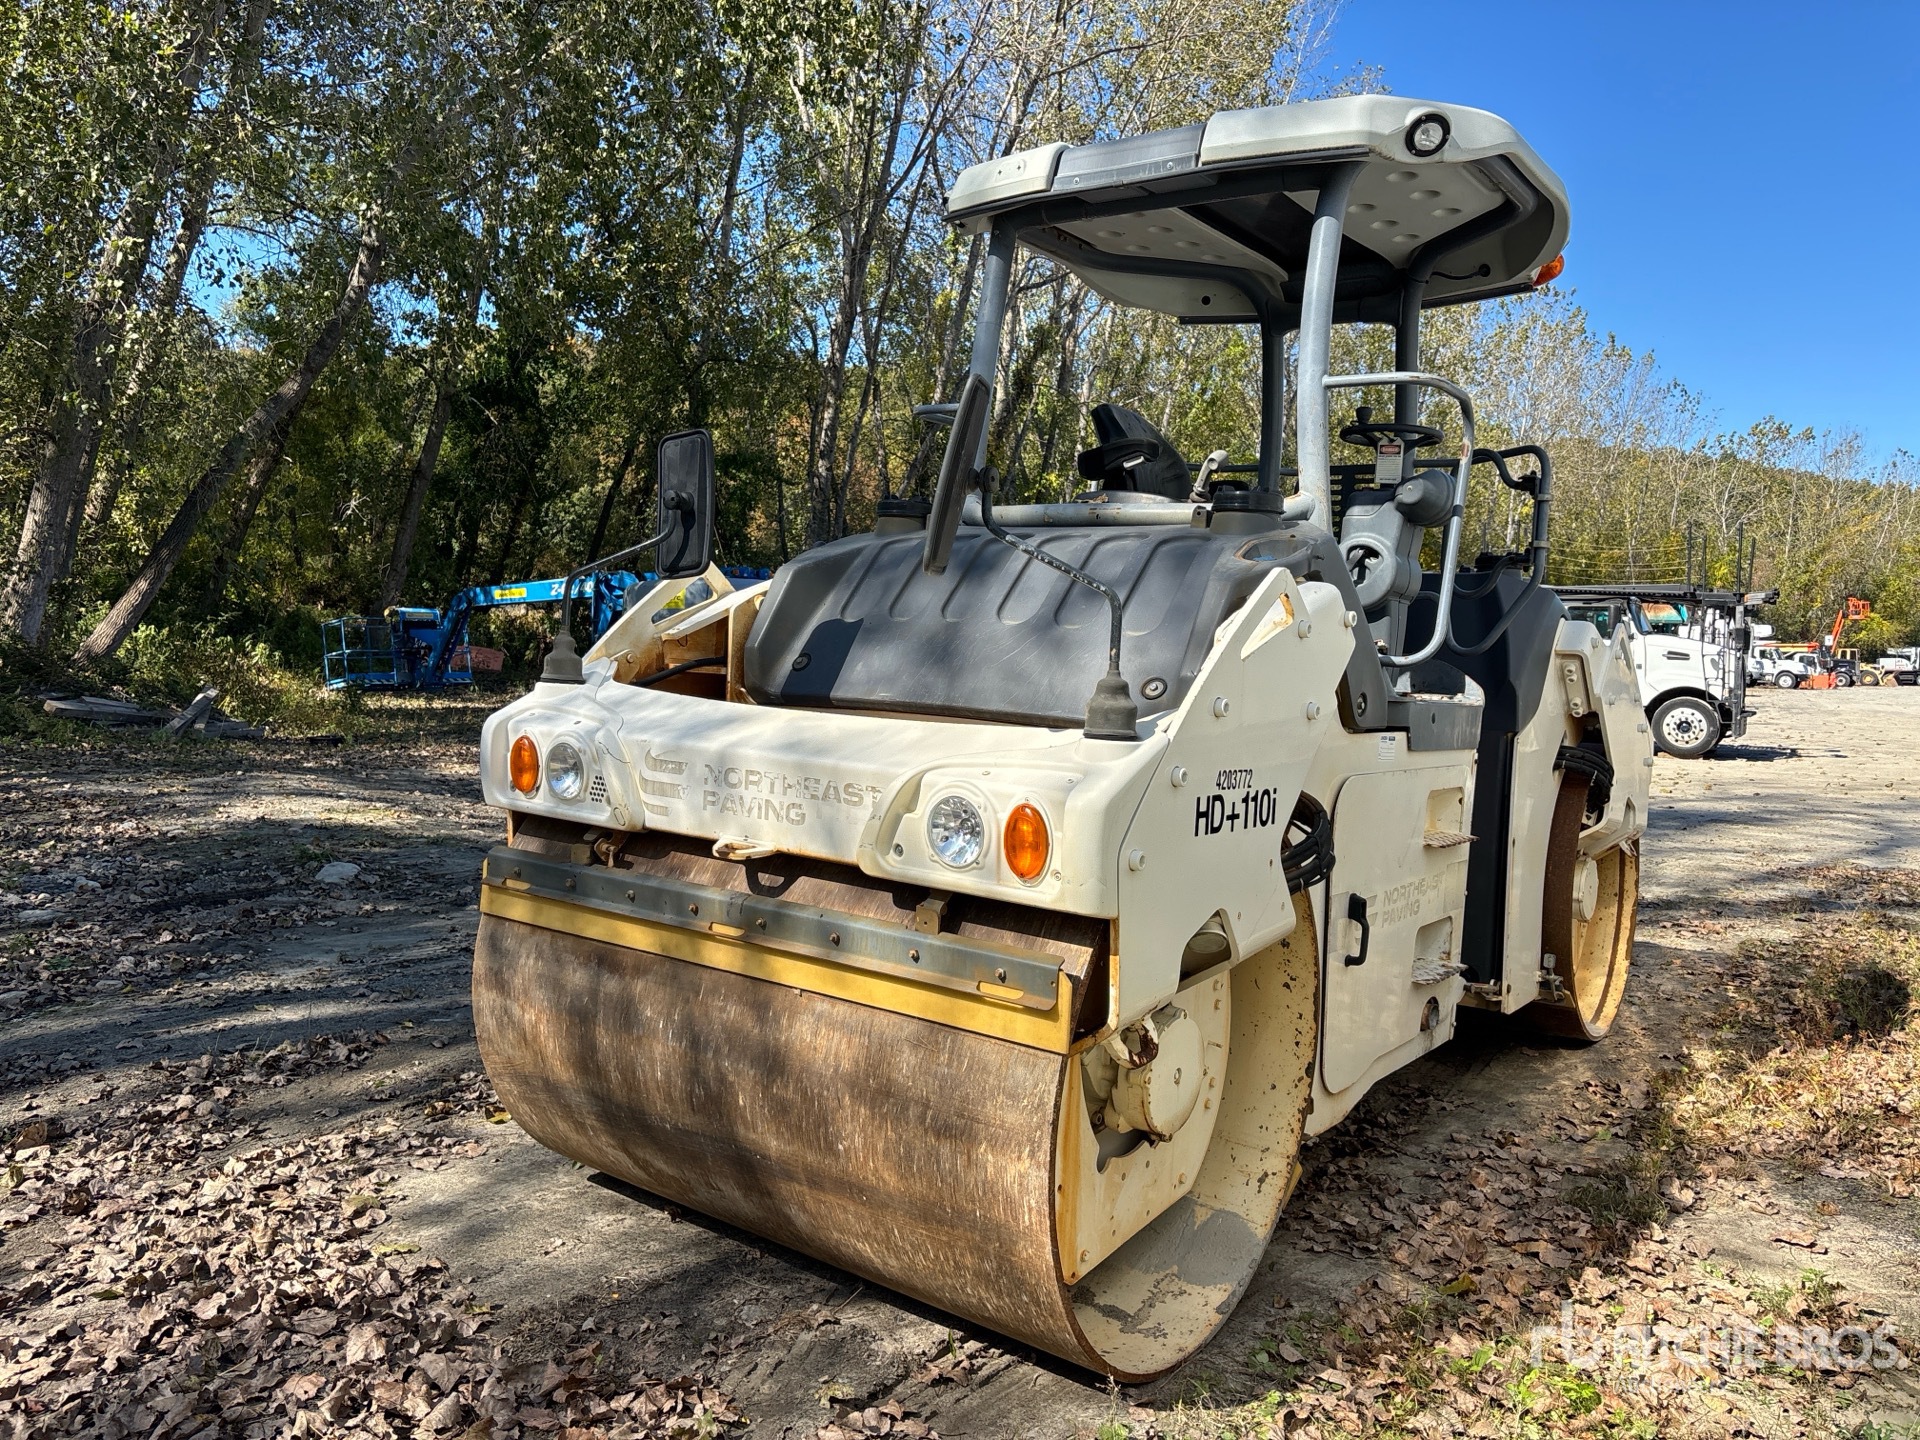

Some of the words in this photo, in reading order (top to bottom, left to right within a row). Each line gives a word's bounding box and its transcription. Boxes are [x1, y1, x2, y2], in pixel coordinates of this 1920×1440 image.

[703, 763, 885, 807] NORTHEAST
[1215, 768, 1253, 790] 4203772
[702, 789, 807, 826] PAVING
[1194, 787, 1277, 837] HD+110i
[1381, 898, 1420, 928] PAVING
